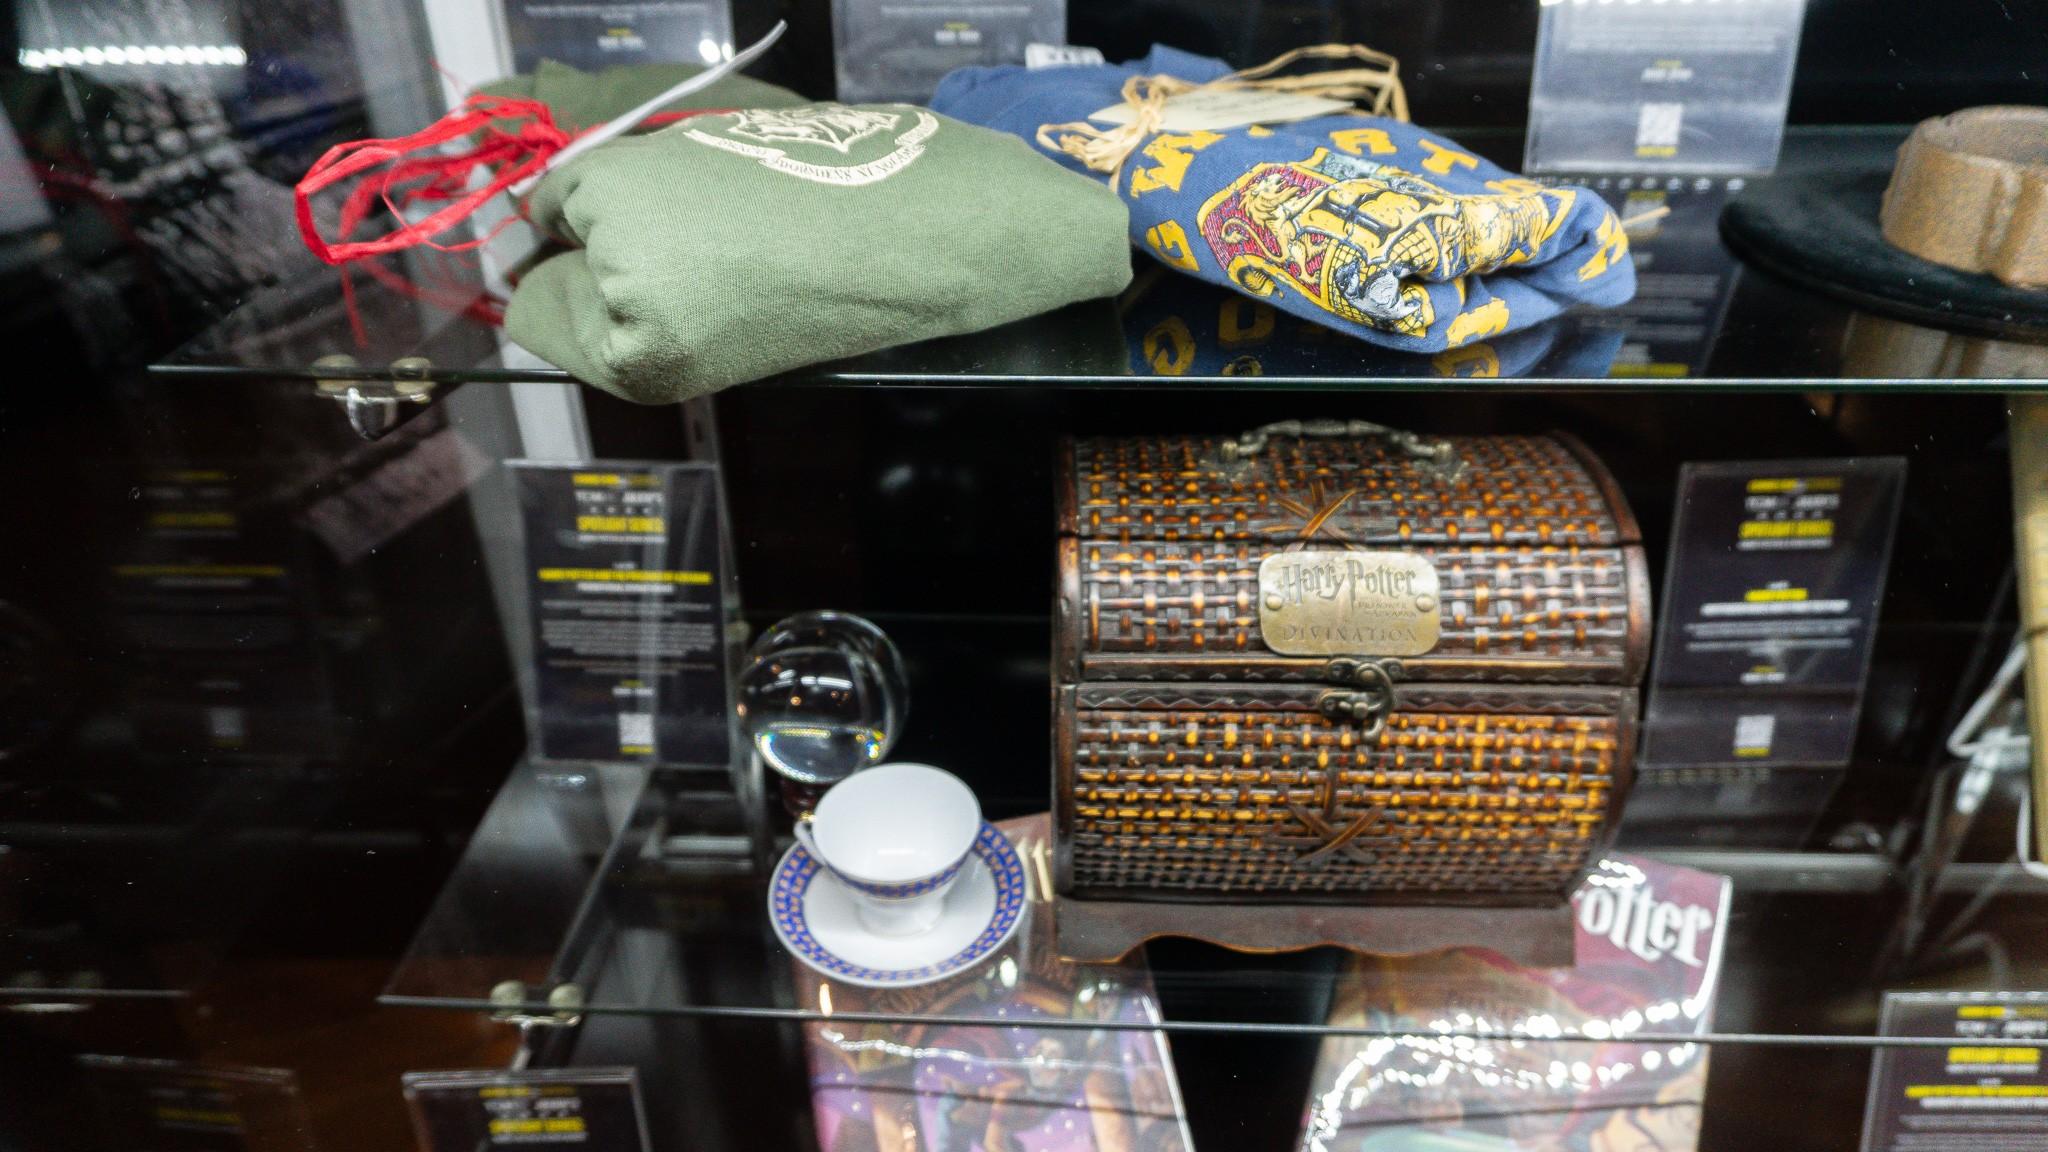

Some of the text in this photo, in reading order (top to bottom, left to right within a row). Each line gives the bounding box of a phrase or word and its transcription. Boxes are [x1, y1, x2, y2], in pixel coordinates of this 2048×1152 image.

[1281, 559, 1417, 613] Harry Potter
[1283, 625, 1417, 642] DIVINATION
[1574, 884, 1714, 968] otter
